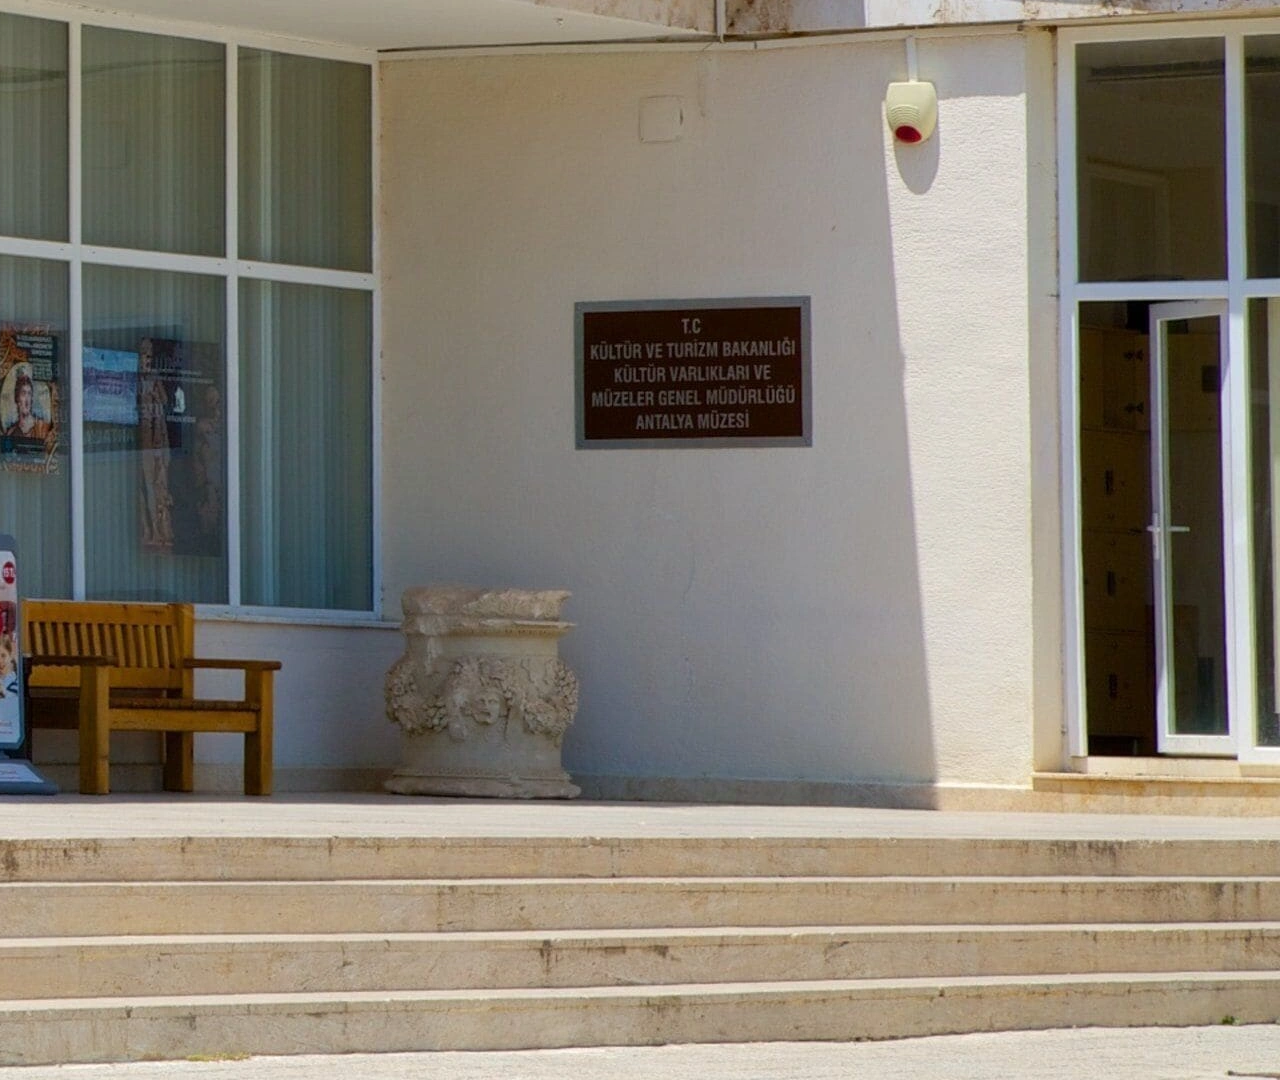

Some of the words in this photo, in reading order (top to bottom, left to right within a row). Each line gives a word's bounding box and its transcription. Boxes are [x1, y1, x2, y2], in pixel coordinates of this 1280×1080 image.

[590, 340, 642, 360] KÜLTÜR
[645, 342, 663, 359] VE
[666, 339, 718, 358] TURİZM
[722, 336, 796, 357] BAKANLIĞI
[614, 364, 666, 383] KÜLTÜR
[669, 365, 750, 382] VARLIKLARI
[753, 364, 771, 380] VE
[591, 388, 654, 407] MÜZELER
[658, 389, 702, 406] GENEL
[706, 384, 796, 405] MÜDÜRLÜĞÜ
[635, 413, 694, 430] ANTALYA
[697, 408, 750, 429] MÜZESİ
